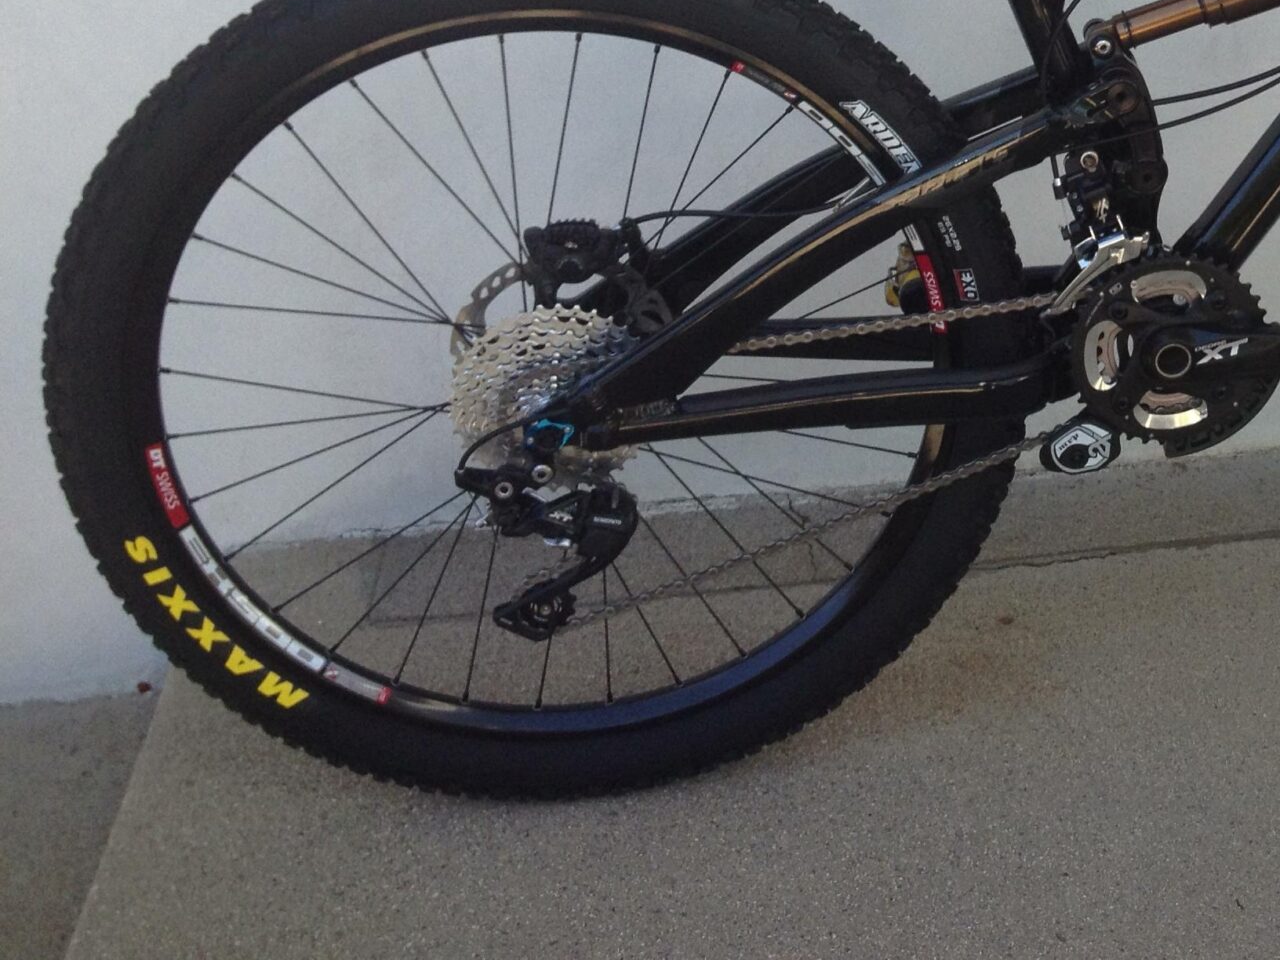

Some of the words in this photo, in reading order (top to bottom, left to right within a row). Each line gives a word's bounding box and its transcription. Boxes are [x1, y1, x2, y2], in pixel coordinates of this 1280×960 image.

[839, 100, 923, 175] ARDEN
[1196, 338, 1249, 365] XT
[149, 447, 166, 469] DT
[156, 470, 181, 510] SWISS
[124, 536, 310, 709] MAXXIS
